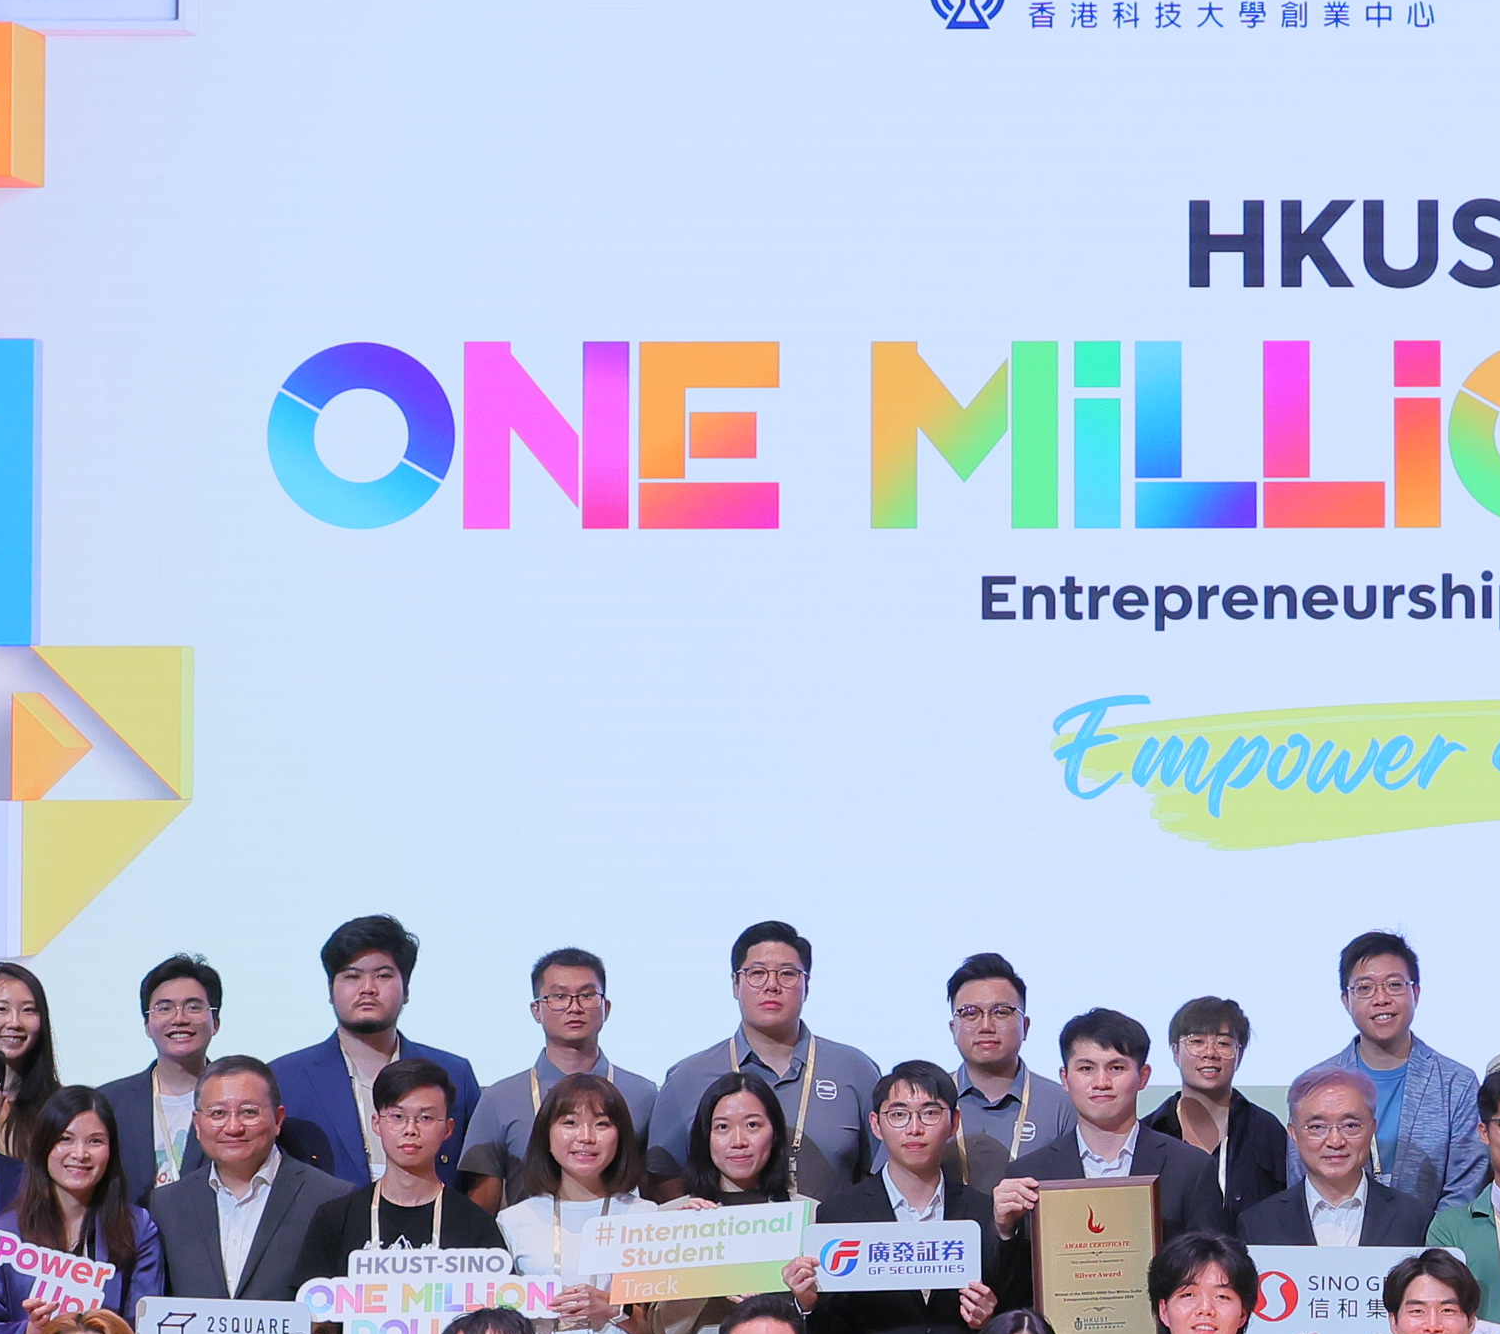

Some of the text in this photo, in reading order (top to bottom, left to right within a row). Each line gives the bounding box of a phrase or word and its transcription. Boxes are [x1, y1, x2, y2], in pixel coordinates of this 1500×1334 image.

[1028, 0, 1436, 30] 香港科技大學創業中心
[267, 340, 780, 530] ONE
[1052, 694, 1469, 819] Empower
[620, 1242, 726, 1268] Student
[867, 1239, 966, 1263] 廣發証券
[355, 1254, 505, 1275] HKUST-SINO
[868, 1264, 966, 1276] GF SECURITIES
[620, 1274, 679, 1299] Track
[1307, 1275, 1360, 1291] SINO
[303, 1283, 388, 1314] ONE
[1307, 1297, 1387, 1320] 信和集
[207, 1316, 290, 1334] 2SQUARE
